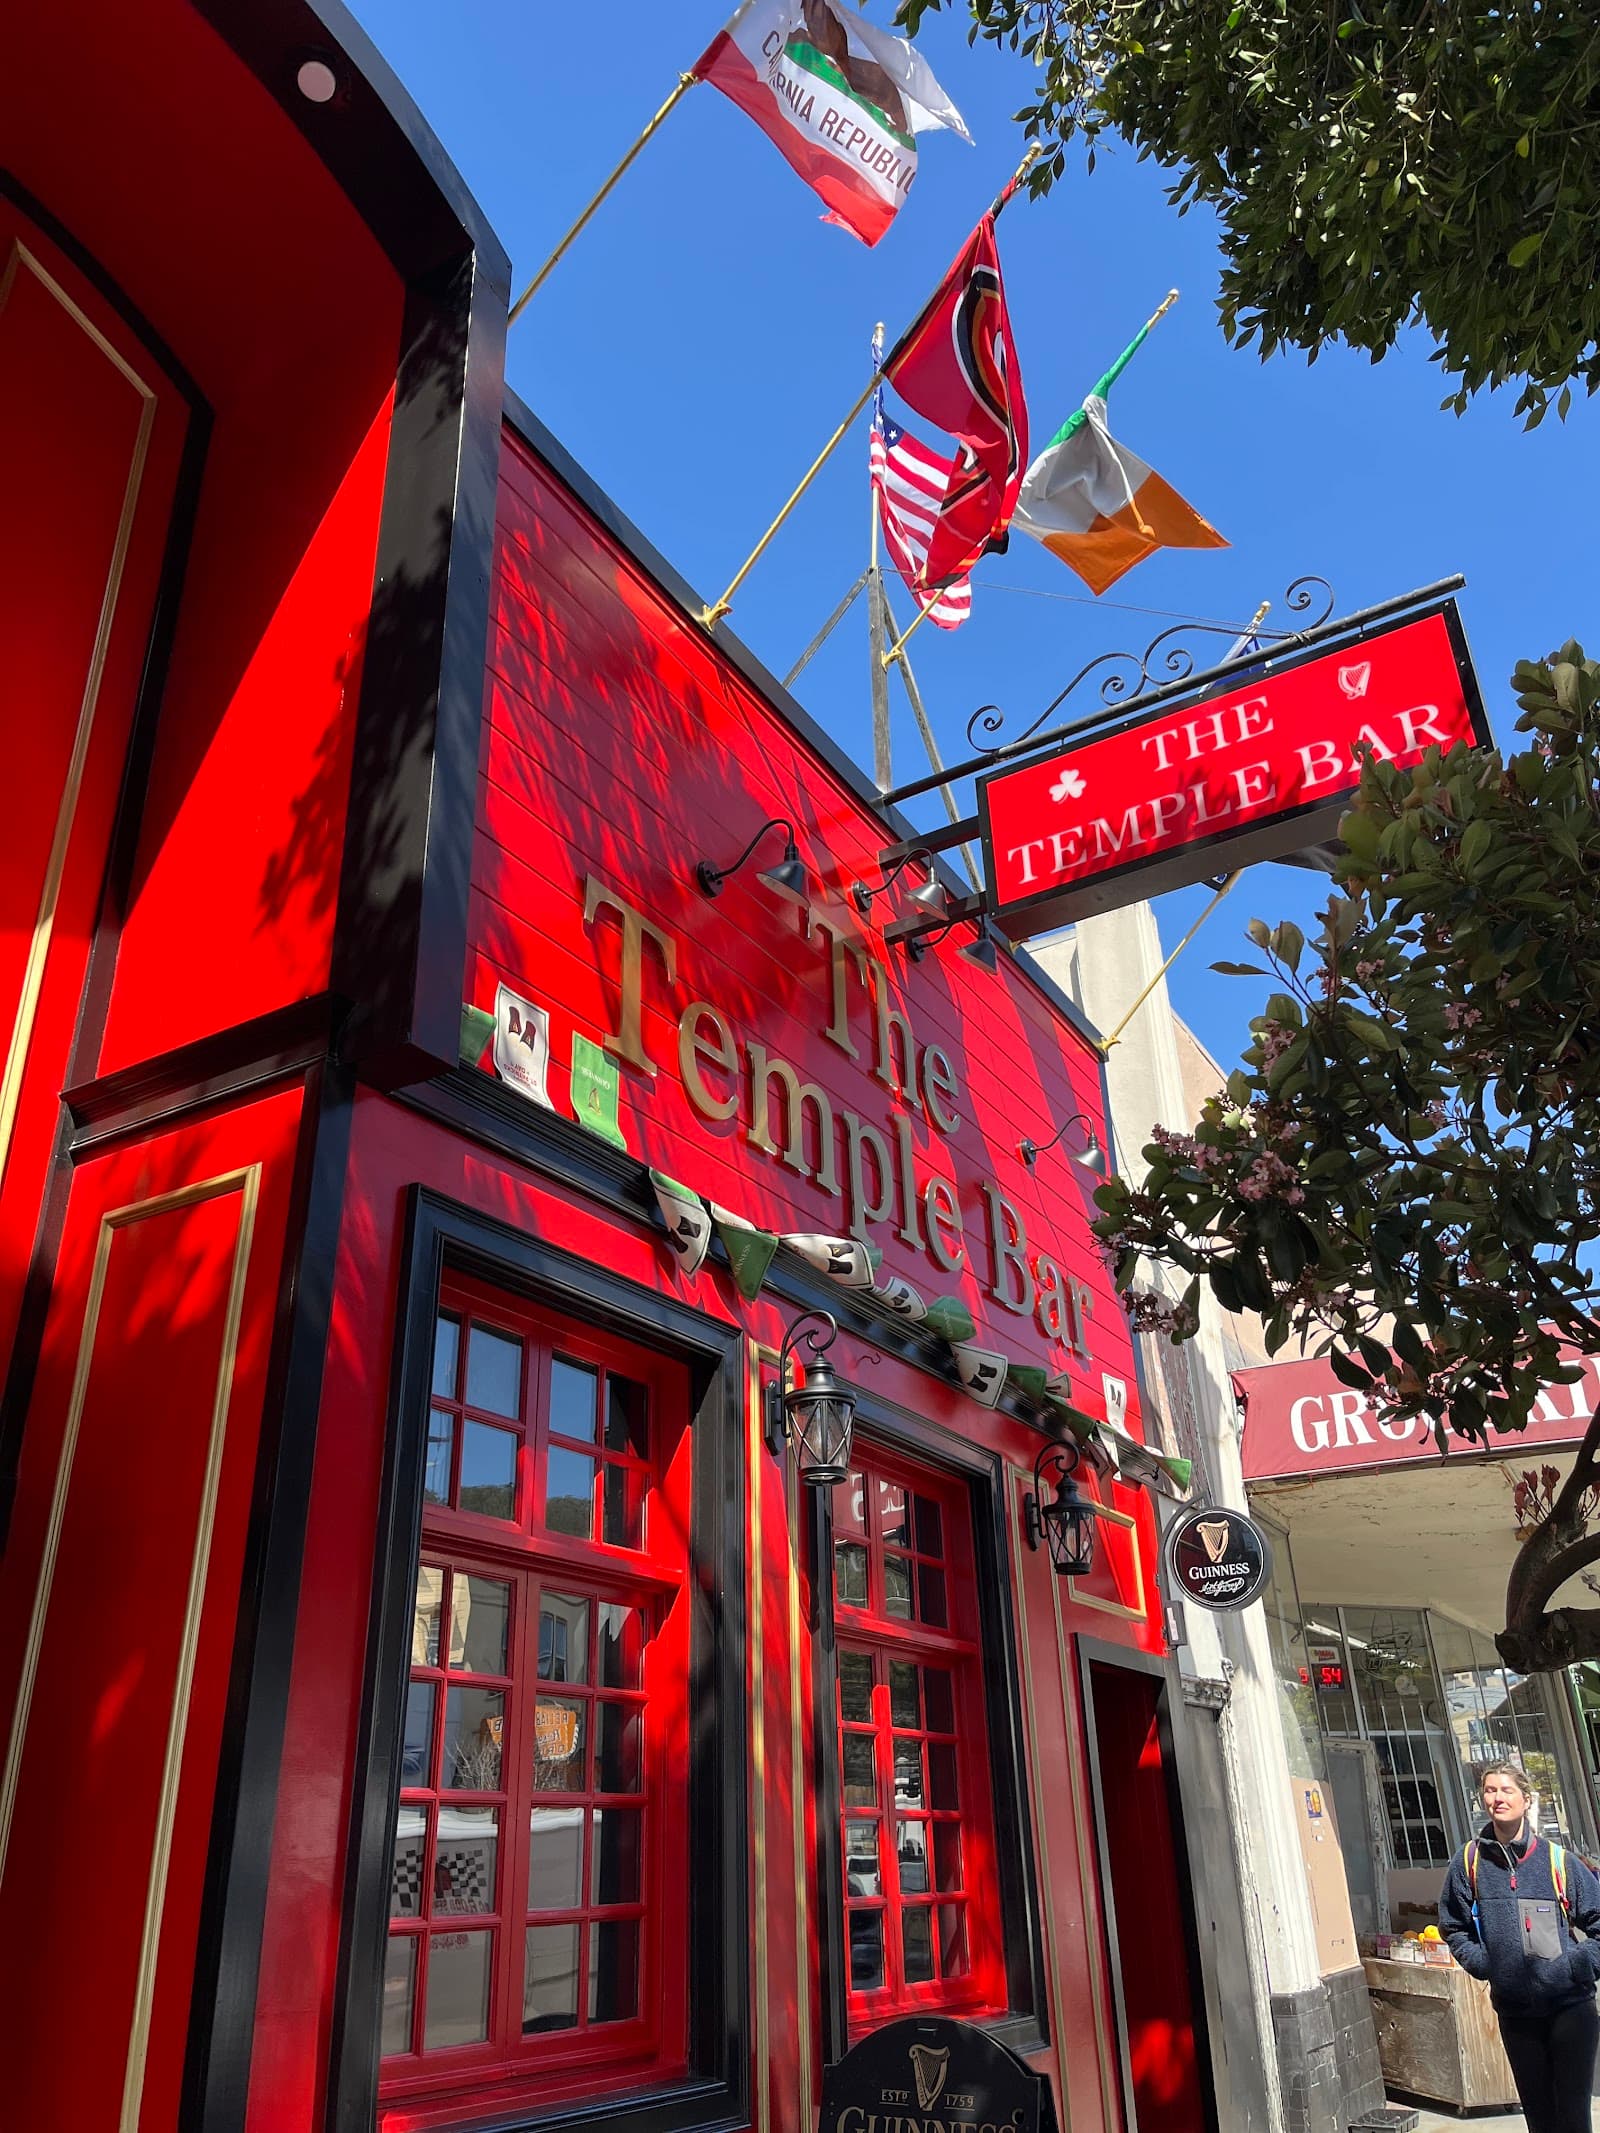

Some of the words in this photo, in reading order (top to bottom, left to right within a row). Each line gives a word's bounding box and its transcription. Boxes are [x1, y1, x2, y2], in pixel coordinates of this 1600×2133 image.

[1142, 696, 1274, 772] THE
[1007, 760, 1276, 885] TEMPLE
[1294, 704, 1452, 788] BAR
[807, 903, 961, 1134] The
[584, 872, 963, 1272] Temple
[982, 1181, 1094, 1361] Bar
[1189, 1562, 1250, 1579] GUINNESS
[1321, 1667, 1342, 1683] 54
[836, 2106, 1016, 2133] GUINN
[945, 2094, 975, 2108] 1759
